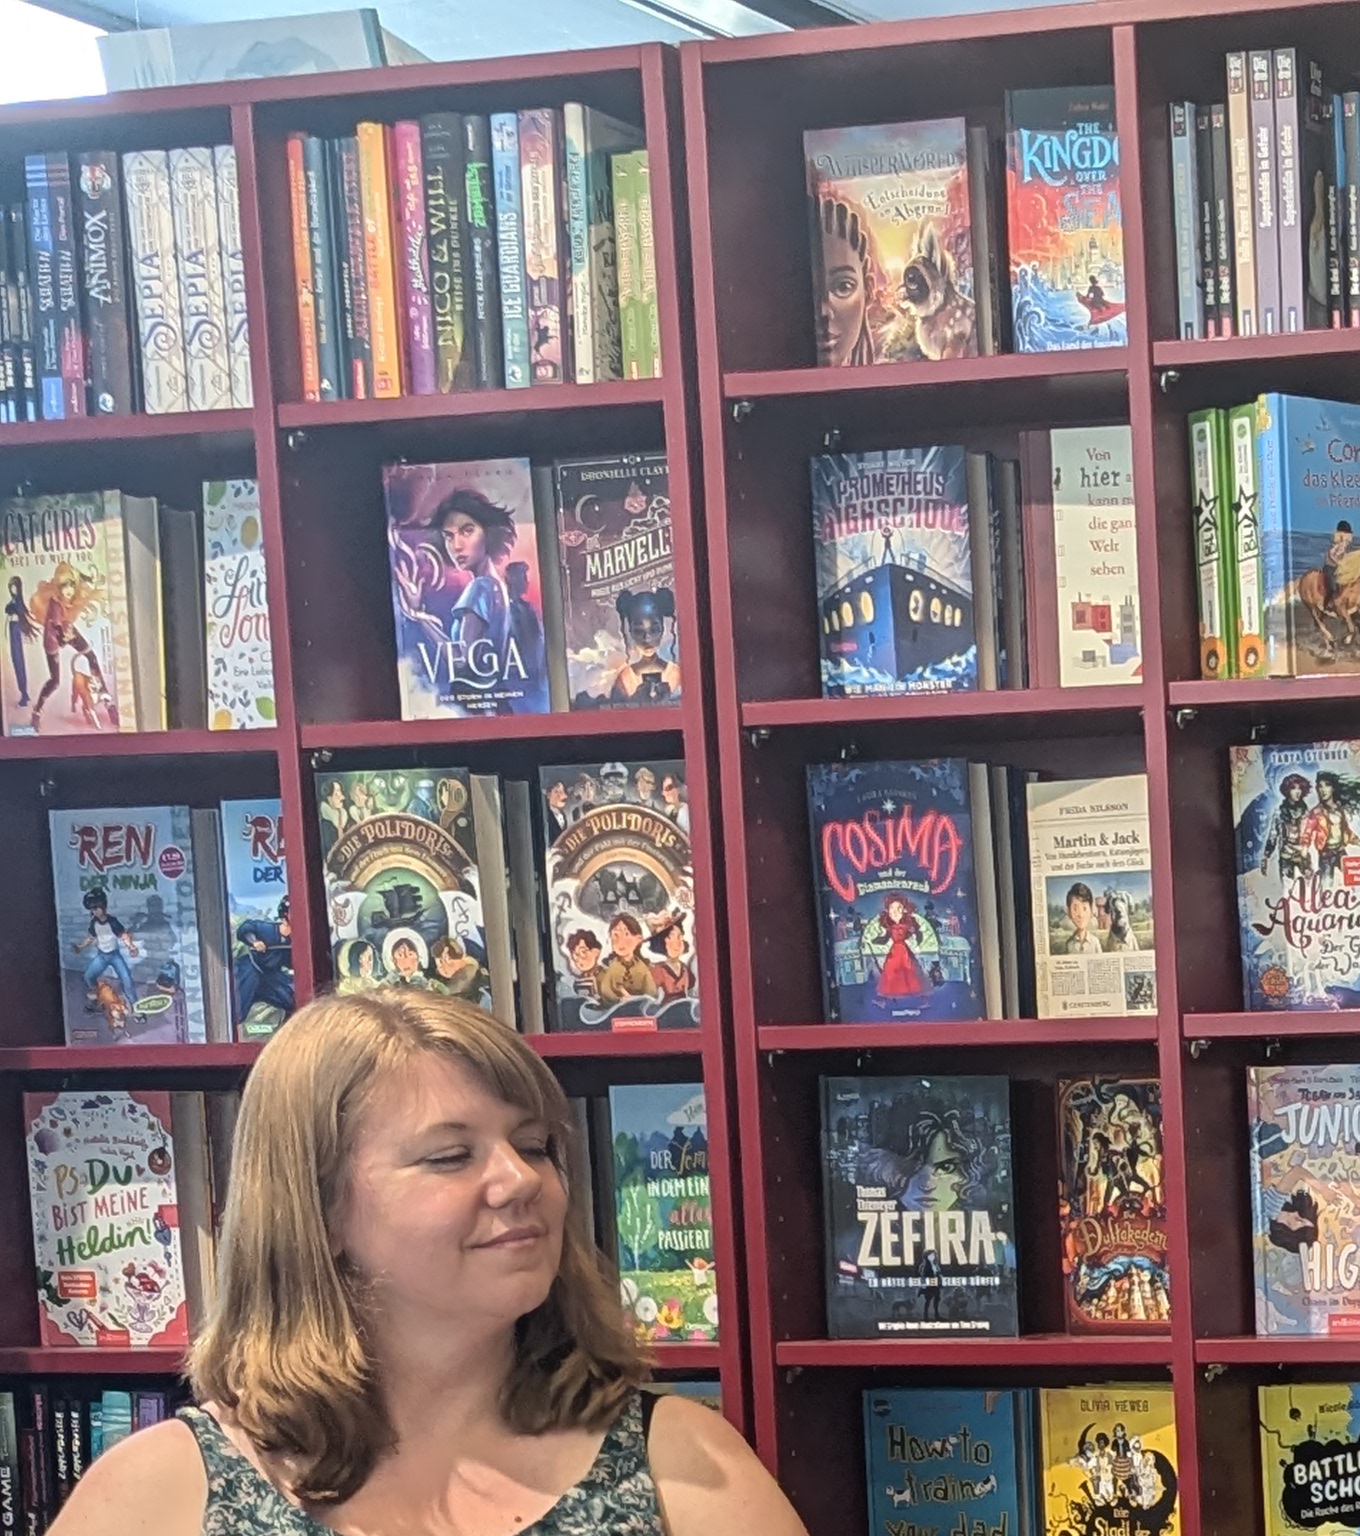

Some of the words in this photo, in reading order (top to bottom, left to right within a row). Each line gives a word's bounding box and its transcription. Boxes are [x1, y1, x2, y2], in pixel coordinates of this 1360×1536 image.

[1075, 121, 1101, 135] THE
[1074, 170, 1107, 182] OVER
[426, 165, 447, 237] WILL
[83, 209, 113, 305] ANIMOX
[431, 242, 450, 265] &
[499, 211, 521, 293] GUARDIANS
[140, 250, 177, 352] SEPIA
[184, 248, 221, 350] SEPIA
[433, 270, 456, 347] NICO
[504, 296, 522, 320] ICE
[1086, 448, 1111, 462] Von
[836, 470, 946, 504] PROMETHEUS
[1080, 467, 1120, 488] hier
[1303, 469, 1328, 488] das
[42, 508, 97, 552] GIRLS
[1089, 517, 1107, 531] die
[586, 526, 673, 582] MARVELL
[1090, 538, 1120, 553] Welt
[1091, 564, 1125, 577] sehen
[417, 637, 529, 690] VEGA
[68, 823, 156, 873] REN
[341, 836, 361, 860] DIE
[361, 821, 455, 859] POLIDORIS
[565, 829, 587, 852] DIE
[586, 812, 677, 848] POLIDORIS
[1053, 834, 1097, 850] Martin
[1099, 833, 1110, 846] &
[1112, 830, 1140, 846] Jack
[821, 804, 964, 903] COSIMA
[80, 874, 110, 893] DER
[113, 873, 158, 892] NINJA
[253, 867, 286, 883] DER
[1321, 936, 1345, 955] Der
[650, 1149, 676, 1171] DER
[56, 1219, 151, 1266] Heldin!
[856, 1210, 995, 1267] ZEFIRA
[958, 1423, 992, 1466] to
[1, 1466, 14, 1526] GAME
[906, 1471, 977, 1505] train
[1301, 1508, 1315, 1519] Die
